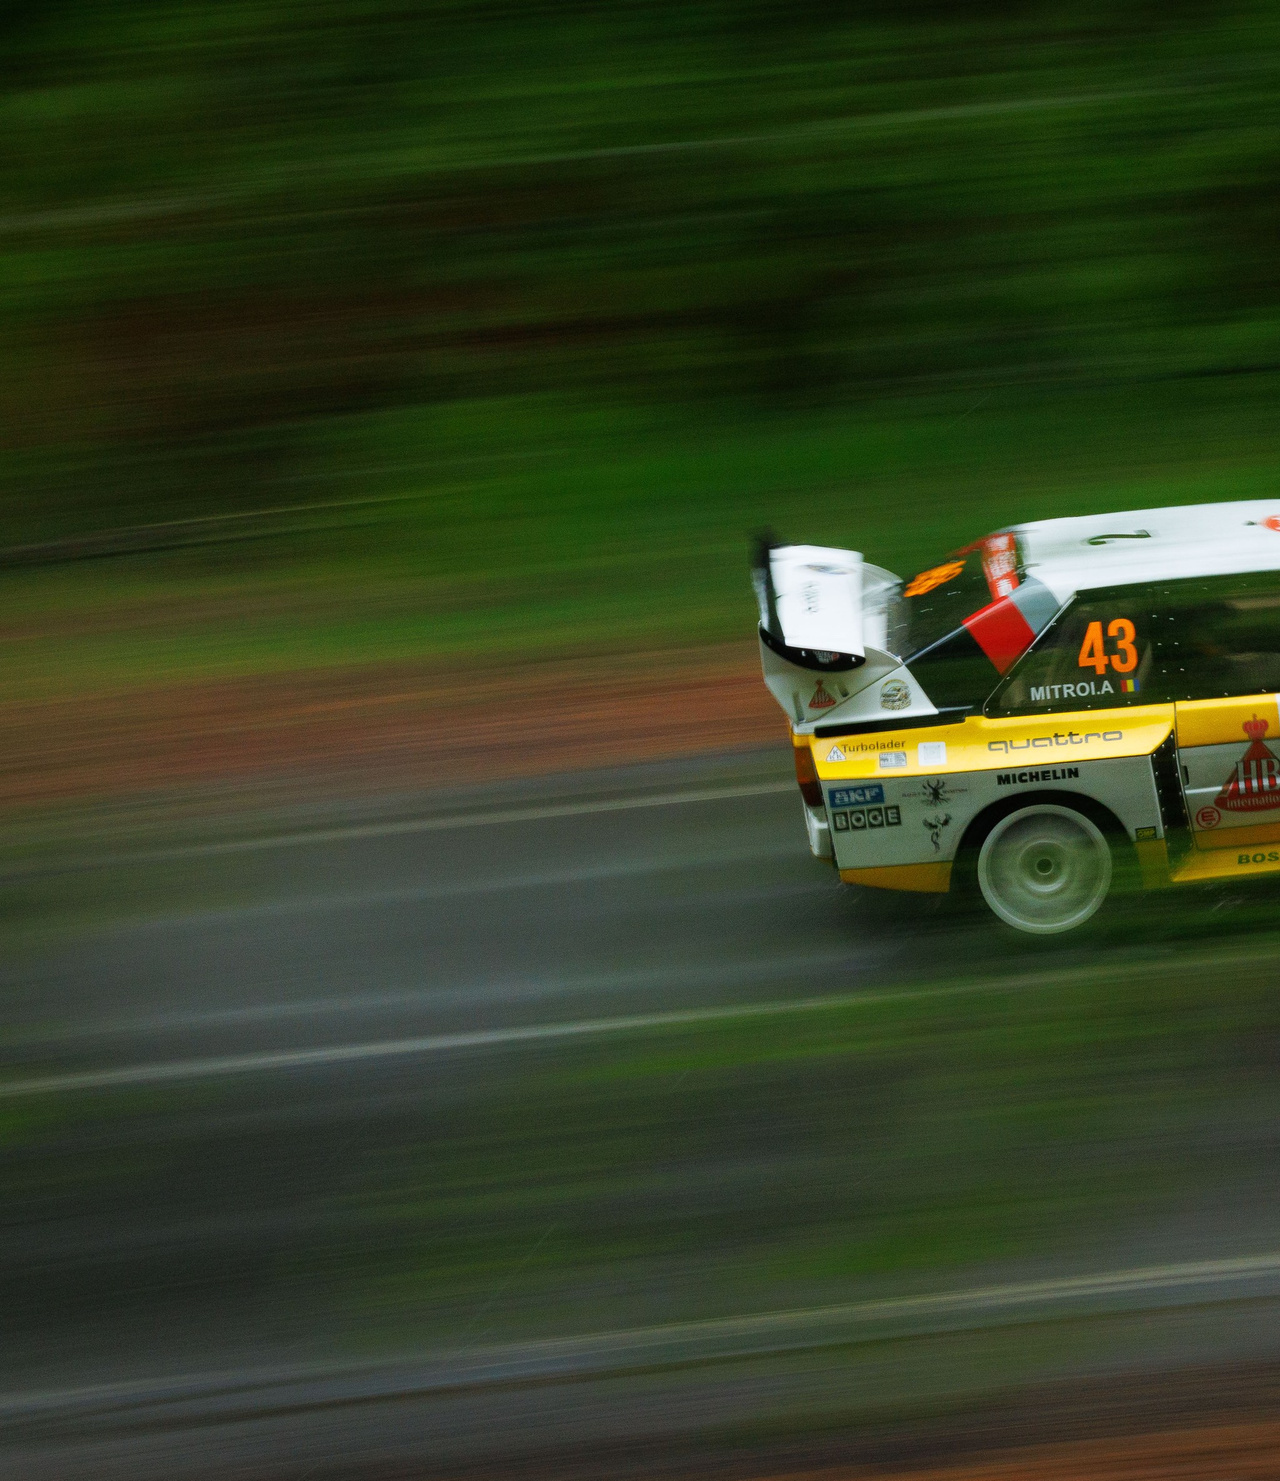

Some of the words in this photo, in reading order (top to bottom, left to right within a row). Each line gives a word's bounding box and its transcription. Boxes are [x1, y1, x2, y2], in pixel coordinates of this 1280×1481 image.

[1078, 617, 1139, 675] 43
[1030, 680, 1115, 701] MITROI.A
[841, 739, 906, 754] Turbolader
[987, 730, 1123, 754] quattro
[996, 767, 1080, 786] MICHELIN
[834, 787, 880, 805] SKF
[834, 808, 900, 831] BOGE
